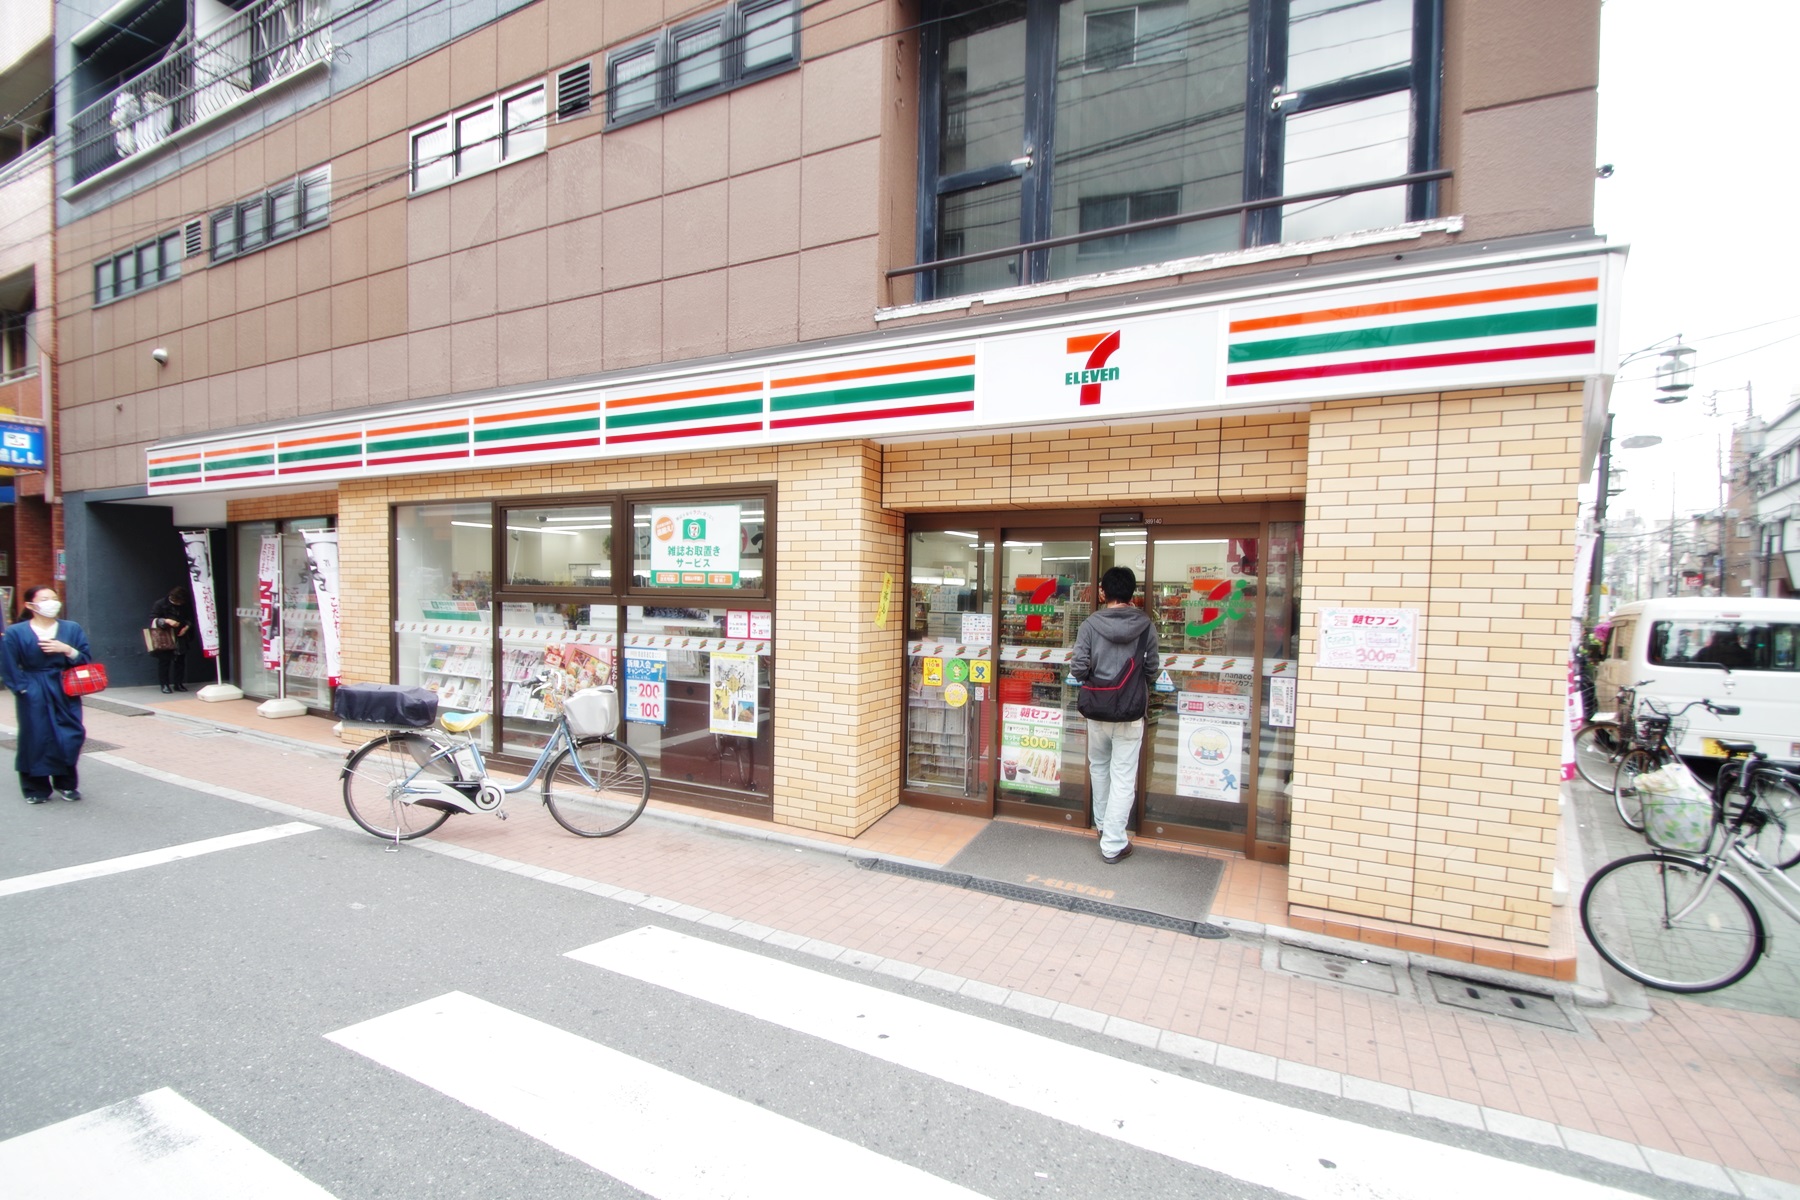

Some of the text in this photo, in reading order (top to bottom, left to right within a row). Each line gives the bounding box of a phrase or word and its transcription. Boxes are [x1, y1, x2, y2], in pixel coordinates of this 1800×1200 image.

[1066, 329, 1121, 406] 7
[1065, 366, 1120, 386] ELEVEn
[667, 545, 721, 557] 雑誌お取置き
[676, 558, 711, 568] サービス
[1352, 614, 1399, 626] 朝セブン
[1356, 648, 1396, 663] 300円
[626, 659, 651, 669] 新規入会
[626, 667, 652, 676] キャンペーン
[1224, 672, 1252, 680] nanaco
[1019, 707, 1061, 721] 朝セブン
[1020, 735, 1056, 750] 300円
